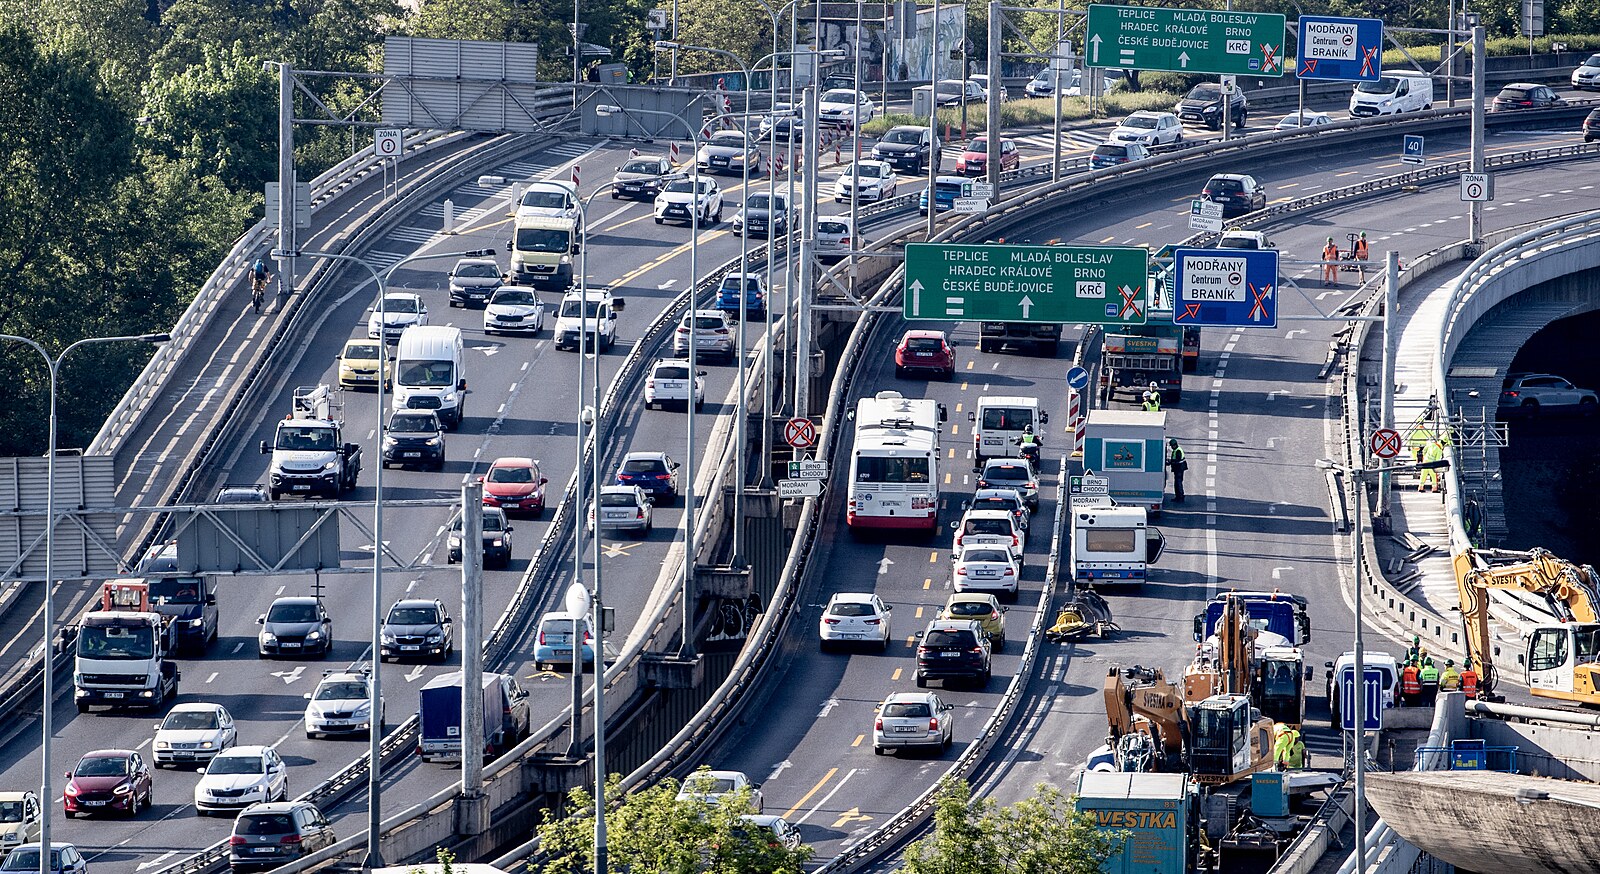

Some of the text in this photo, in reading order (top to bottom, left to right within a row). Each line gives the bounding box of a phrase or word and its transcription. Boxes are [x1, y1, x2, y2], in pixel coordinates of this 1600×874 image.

[1118, 9, 1258, 25] TEPLICE MLADÁ BOLESLAV
[1120, 22, 1252, 37] HRADEC KRÁLOVÉ BRNO
[1308, 23, 1355, 35] MODŘANY
[1118, 35, 1209, 49] ČESKÉ BUDĚJOVICE
[1228, 41, 1248, 52] KRČ
[1312, 36, 1338, 46] Centrum
[1312, 46, 1348, 57] BRANÍK
[1408, 141, 1419, 151] 40
[1465, 174, 1484, 182] ZÓNA
[943, 250, 1113, 264] TEPLICE MLADÁ BOLESLAV
[1187, 258, 1244, 272] MODŘANY
[949, 265, 1106, 279] HRADEC KRÁLOVÉ BRNO
[1191, 274, 1222, 285] Centrum
[942, 279, 1054, 293] ČESKÉ BUDĚJOVICE
[1079, 282, 1103, 295] KRČ
[1191, 286, 1236, 300] BRANÍK
[1126, 338, 1157, 347] ŠVESTKA
[782, 480, 808, 488] MODŘANY
[1196, 775, 1230, 783] ŠVESTKA
